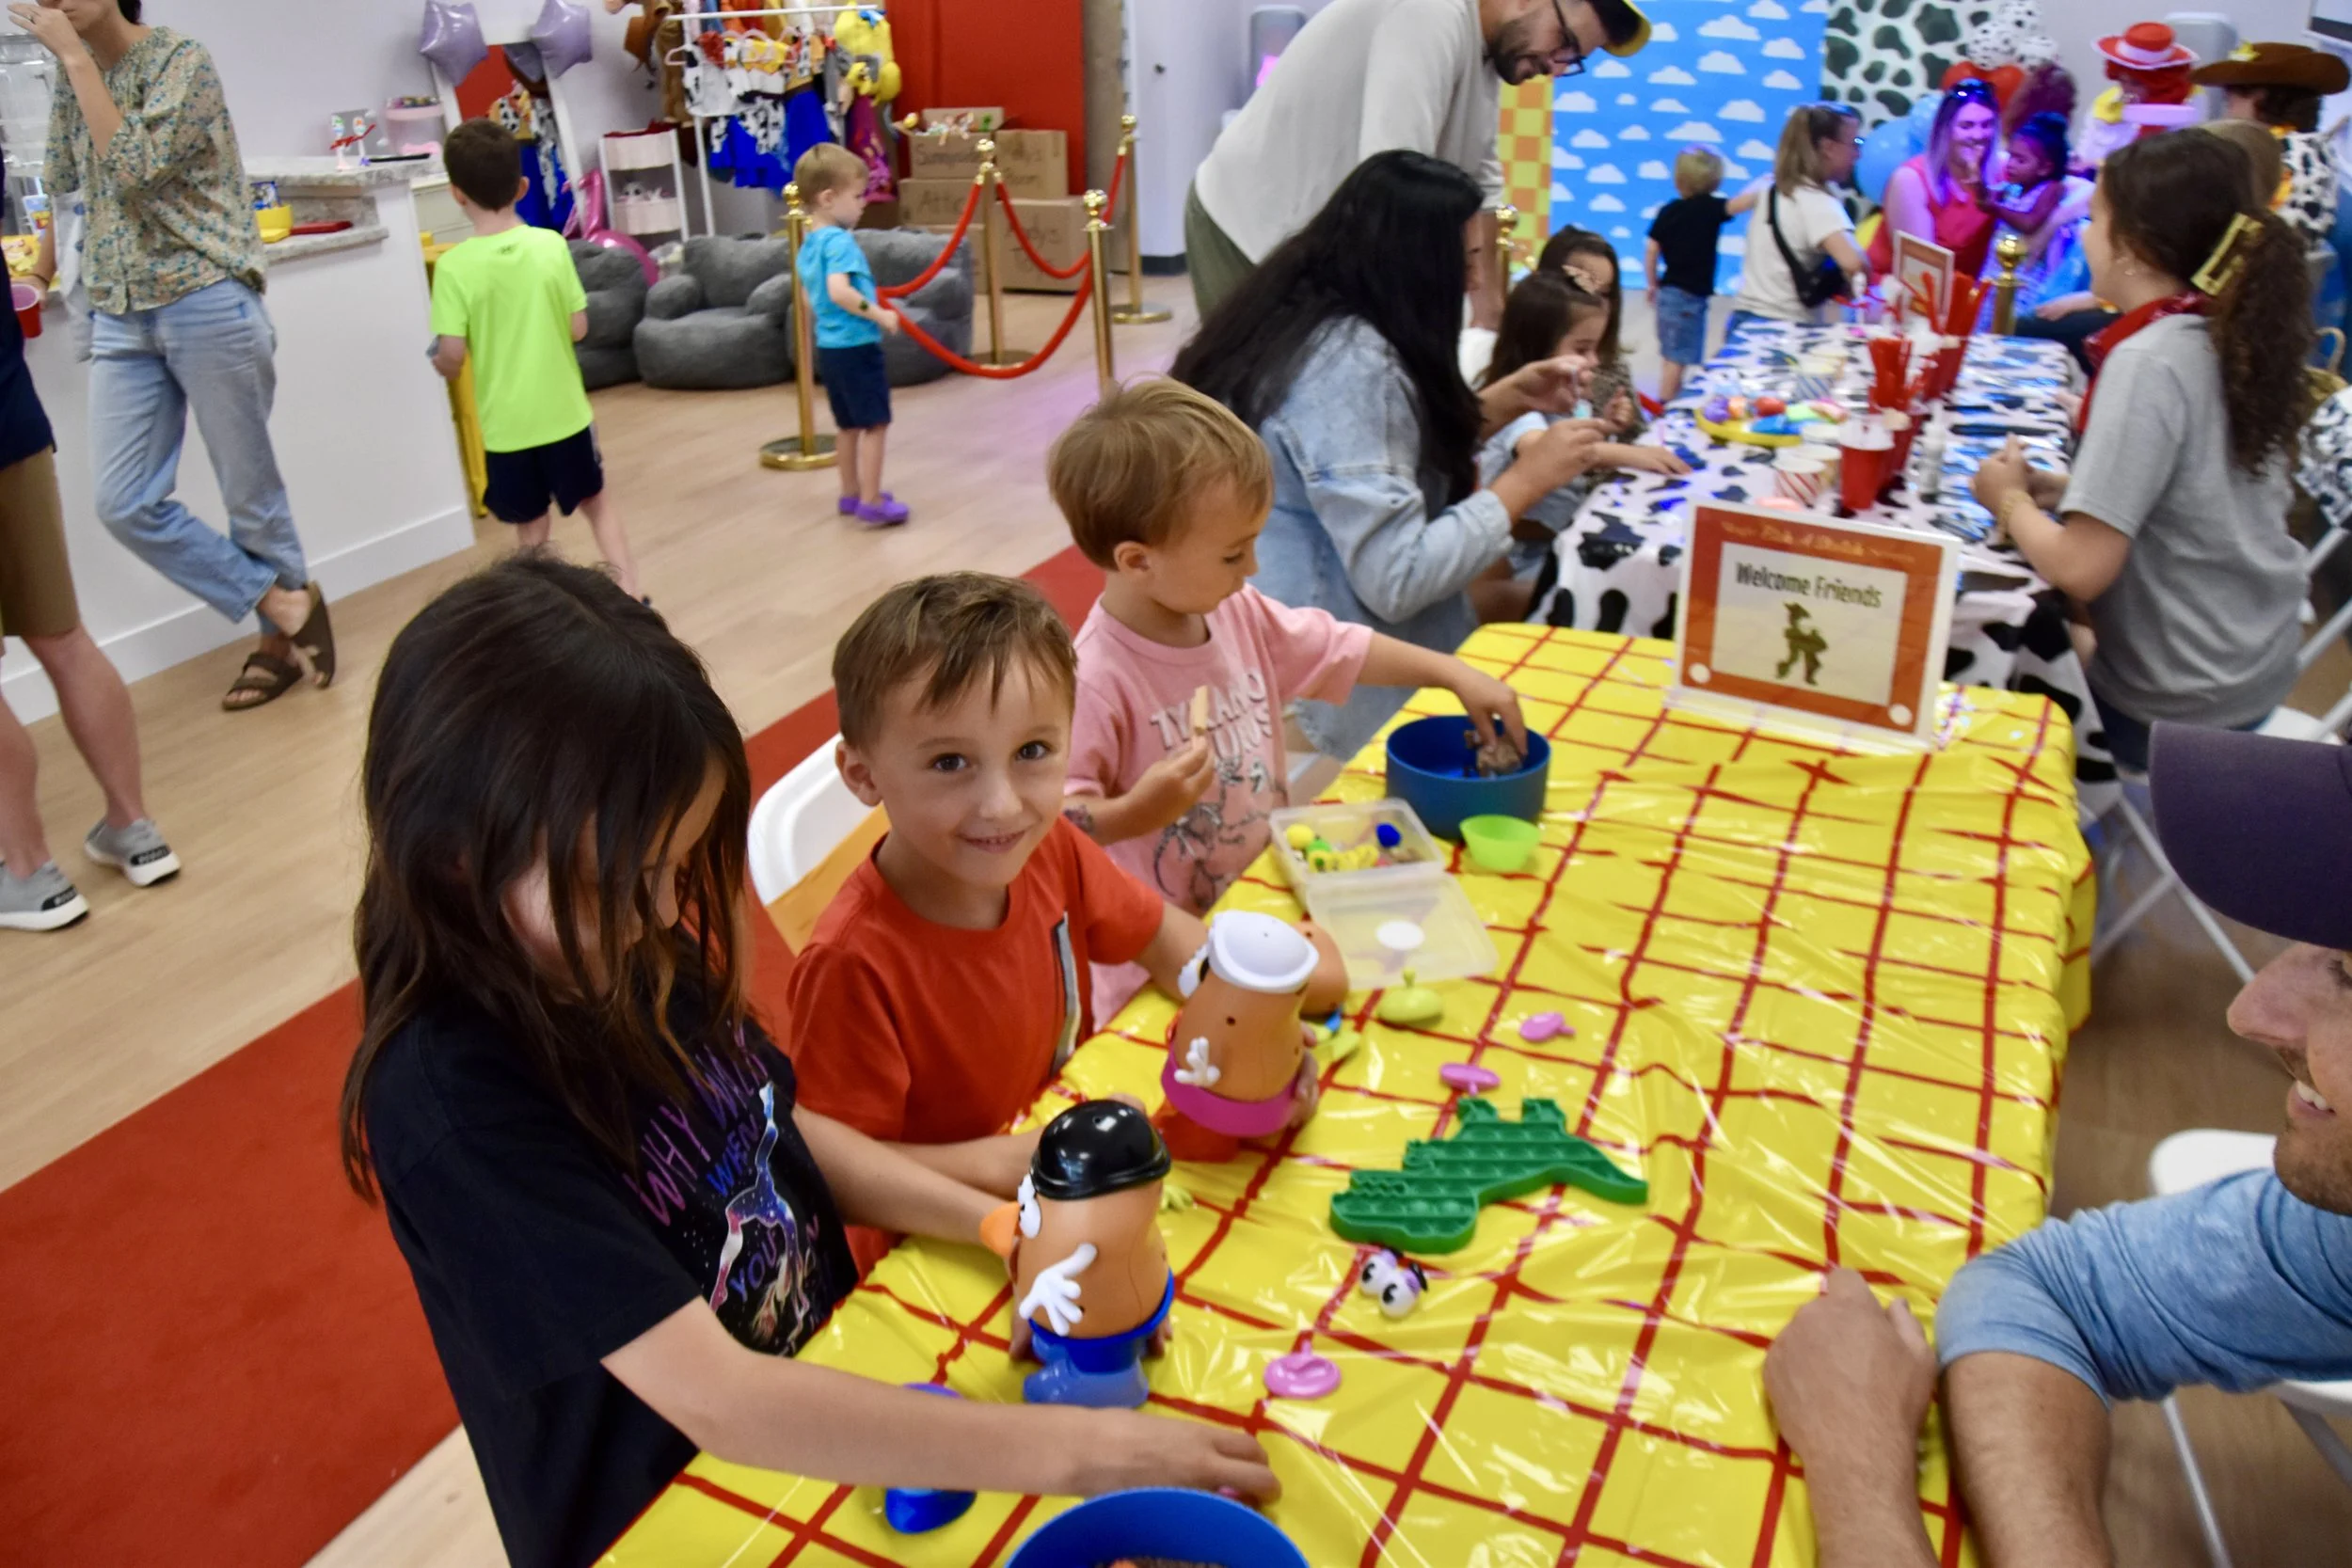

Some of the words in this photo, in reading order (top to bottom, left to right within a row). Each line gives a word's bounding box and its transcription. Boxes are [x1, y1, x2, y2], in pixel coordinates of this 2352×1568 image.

[1736, 562, 1811, 596] Welcome
[1815, 575, 1883, 609] Friends
[622, 1095, 711, 1227] WHY
[707, 1114, 759, 1197] WHEN
[728, 1225, 778, 1304] YOU
